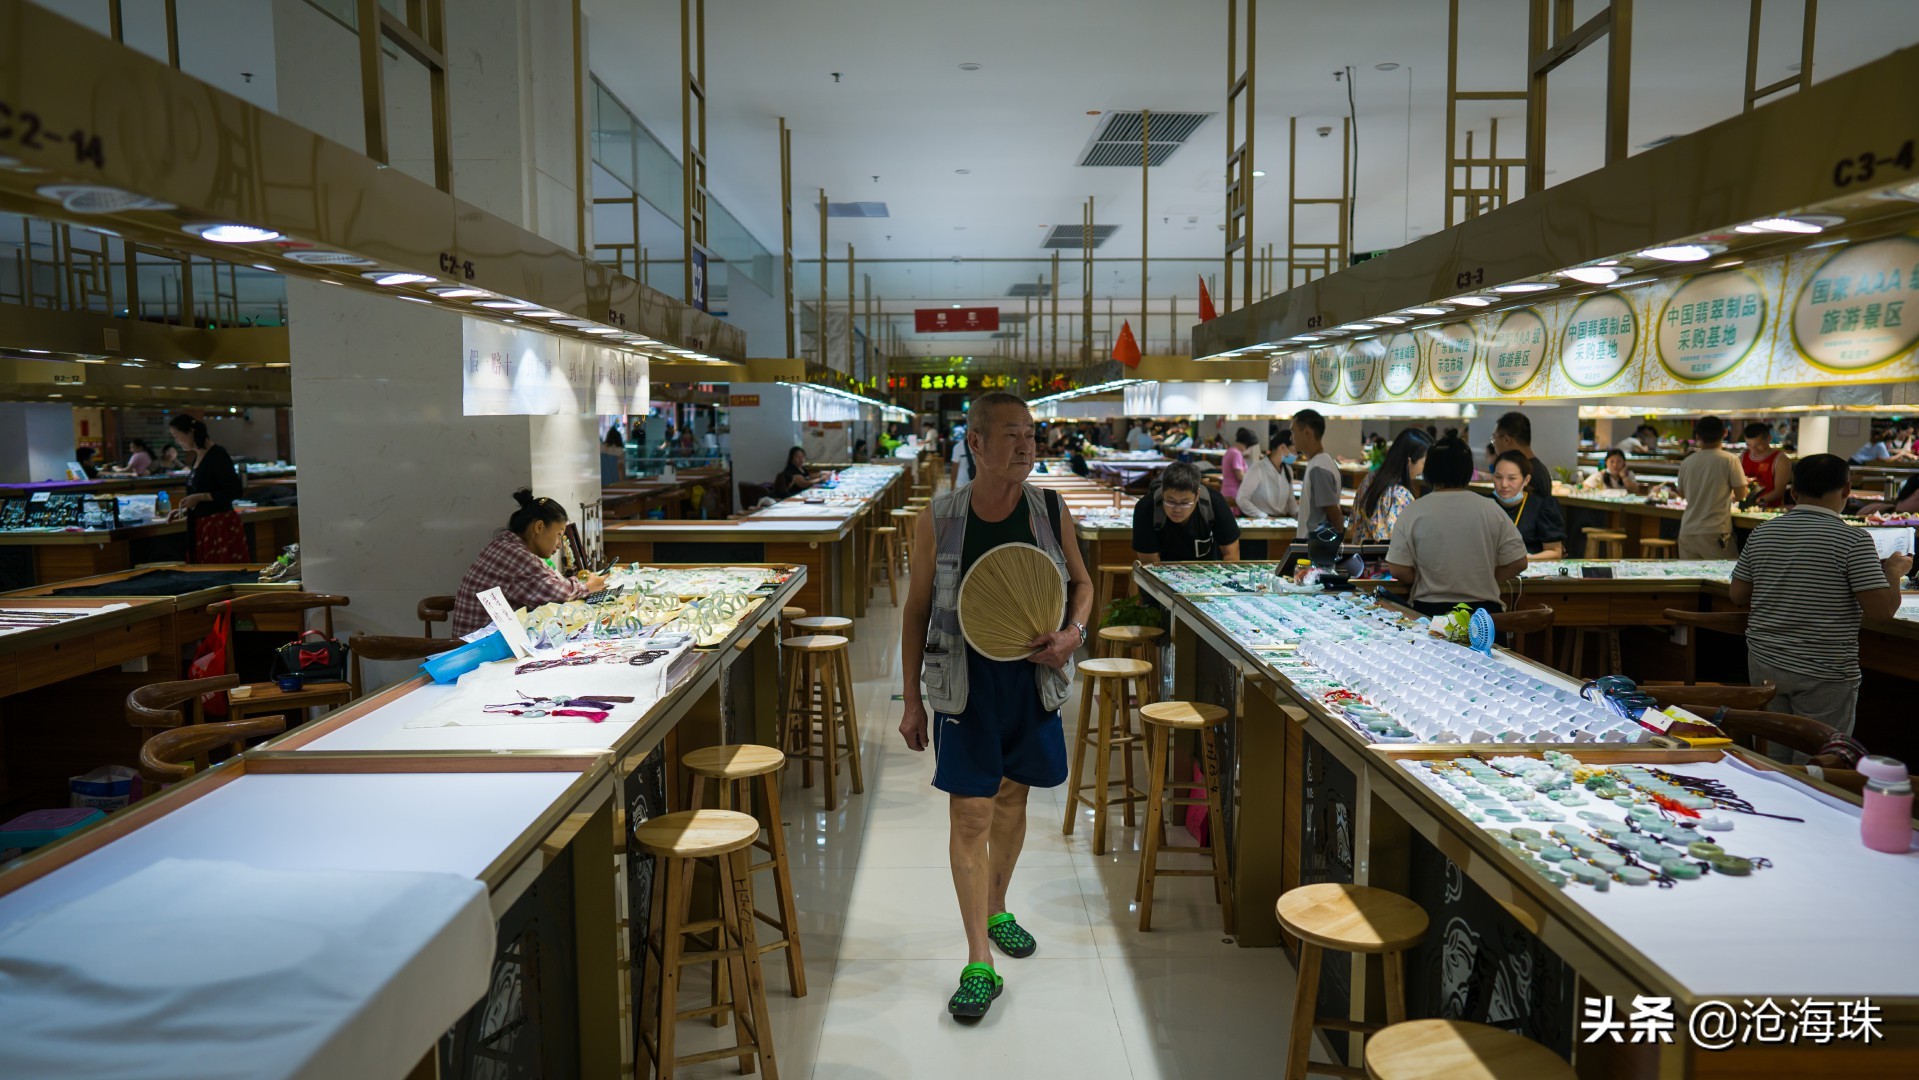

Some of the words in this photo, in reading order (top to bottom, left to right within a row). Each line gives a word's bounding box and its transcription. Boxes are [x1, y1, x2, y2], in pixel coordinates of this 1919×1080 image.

[1833, 140, 1915, 188] C3-4
[439, 253, 475, 280] C2-15
[1456, 267, 1484, 289] C3-3
[692, 263, 703, 304] C2
[1810, 275, 1847, 306] 国家
[1852, 269, 1902, 297] AAA
[1667, 293, 1758, 329] 中国翡翠制品
[1819, 301, 1905, 336] 旅游景区
[1568, 313, 1631, 342] 中国翡翠制品
[1677, 323, 1737, 351] 采购基地
[469, 348, 512, 377] 假一赔十
[1437, 356, 1464, 373] 示范市场
[1497, 350, 1530, 369] 旅游景区
[1574, 338, 1618, 362] 采购基地
